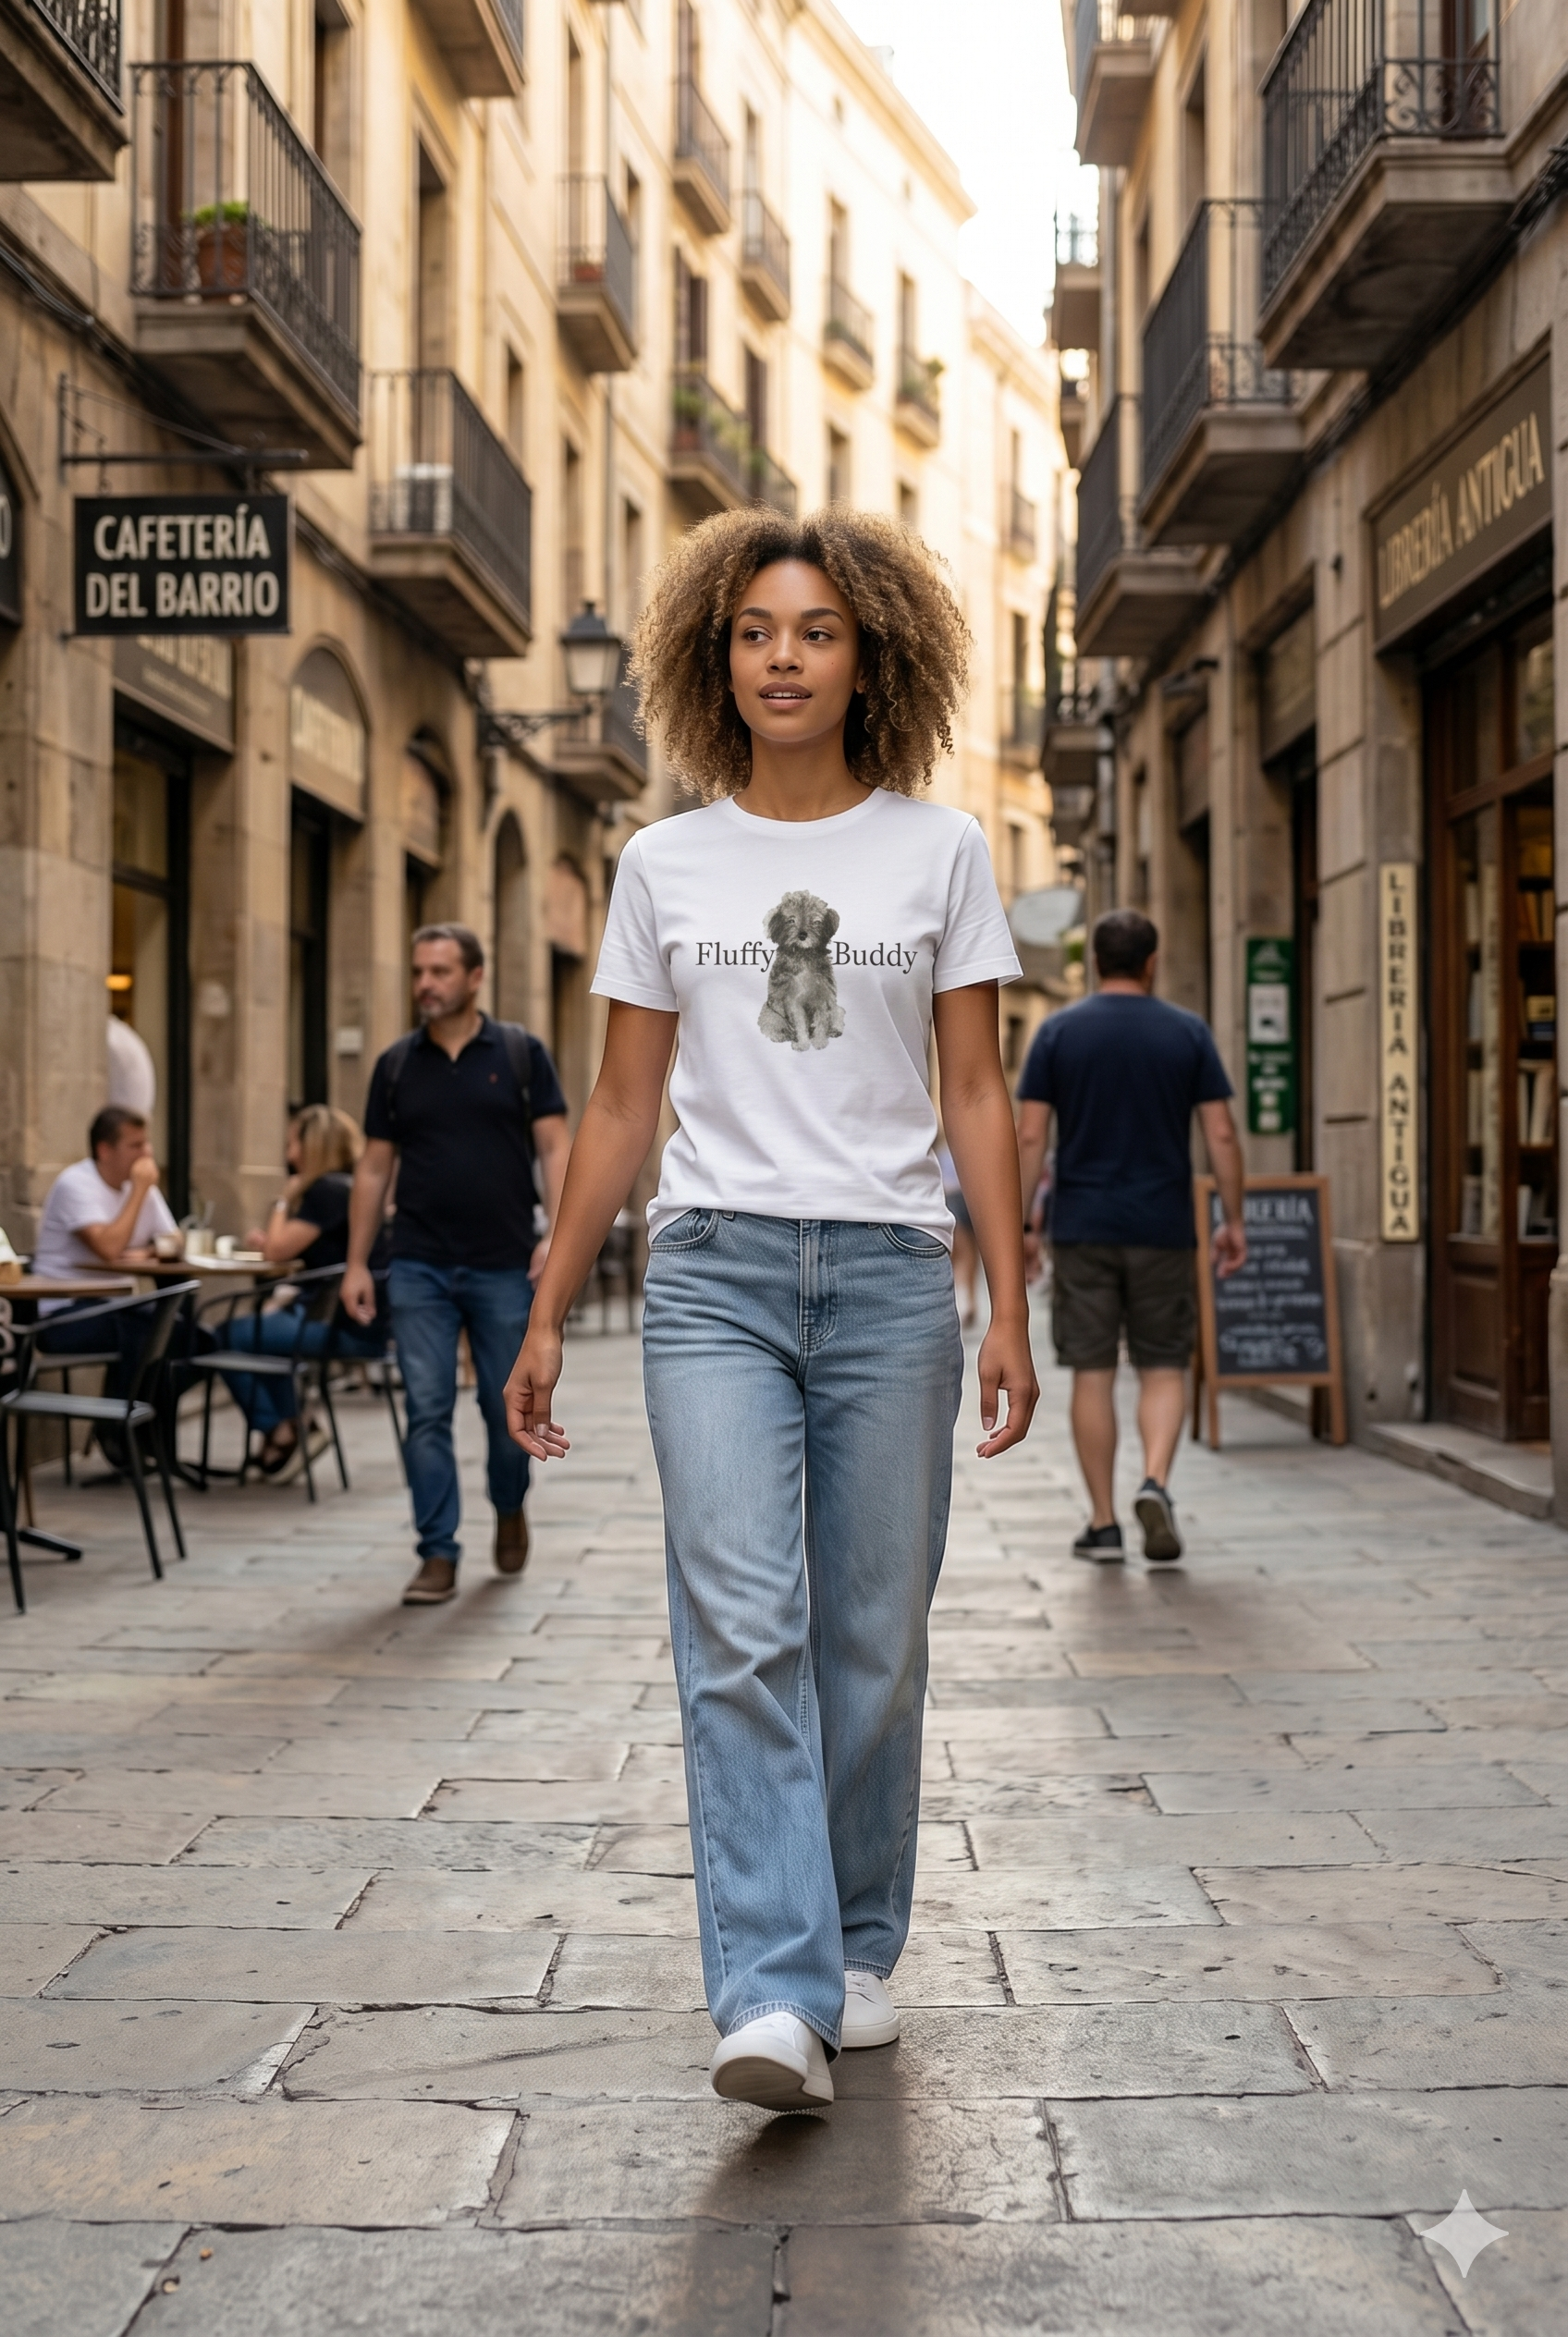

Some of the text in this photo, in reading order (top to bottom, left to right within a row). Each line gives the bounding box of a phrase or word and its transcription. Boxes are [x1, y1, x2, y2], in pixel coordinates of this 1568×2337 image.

[93, 503, 271, 560] CAFETERÍA
[1378, 411, 1544, 609] LIBRERÍA ANTIGUA
[86, 570, 279, 618] DEL BARRIO
[695, 940, 918, 974] Fluffy Buddy
[1390, 1074, 1409, 1233] ANTIGUA
